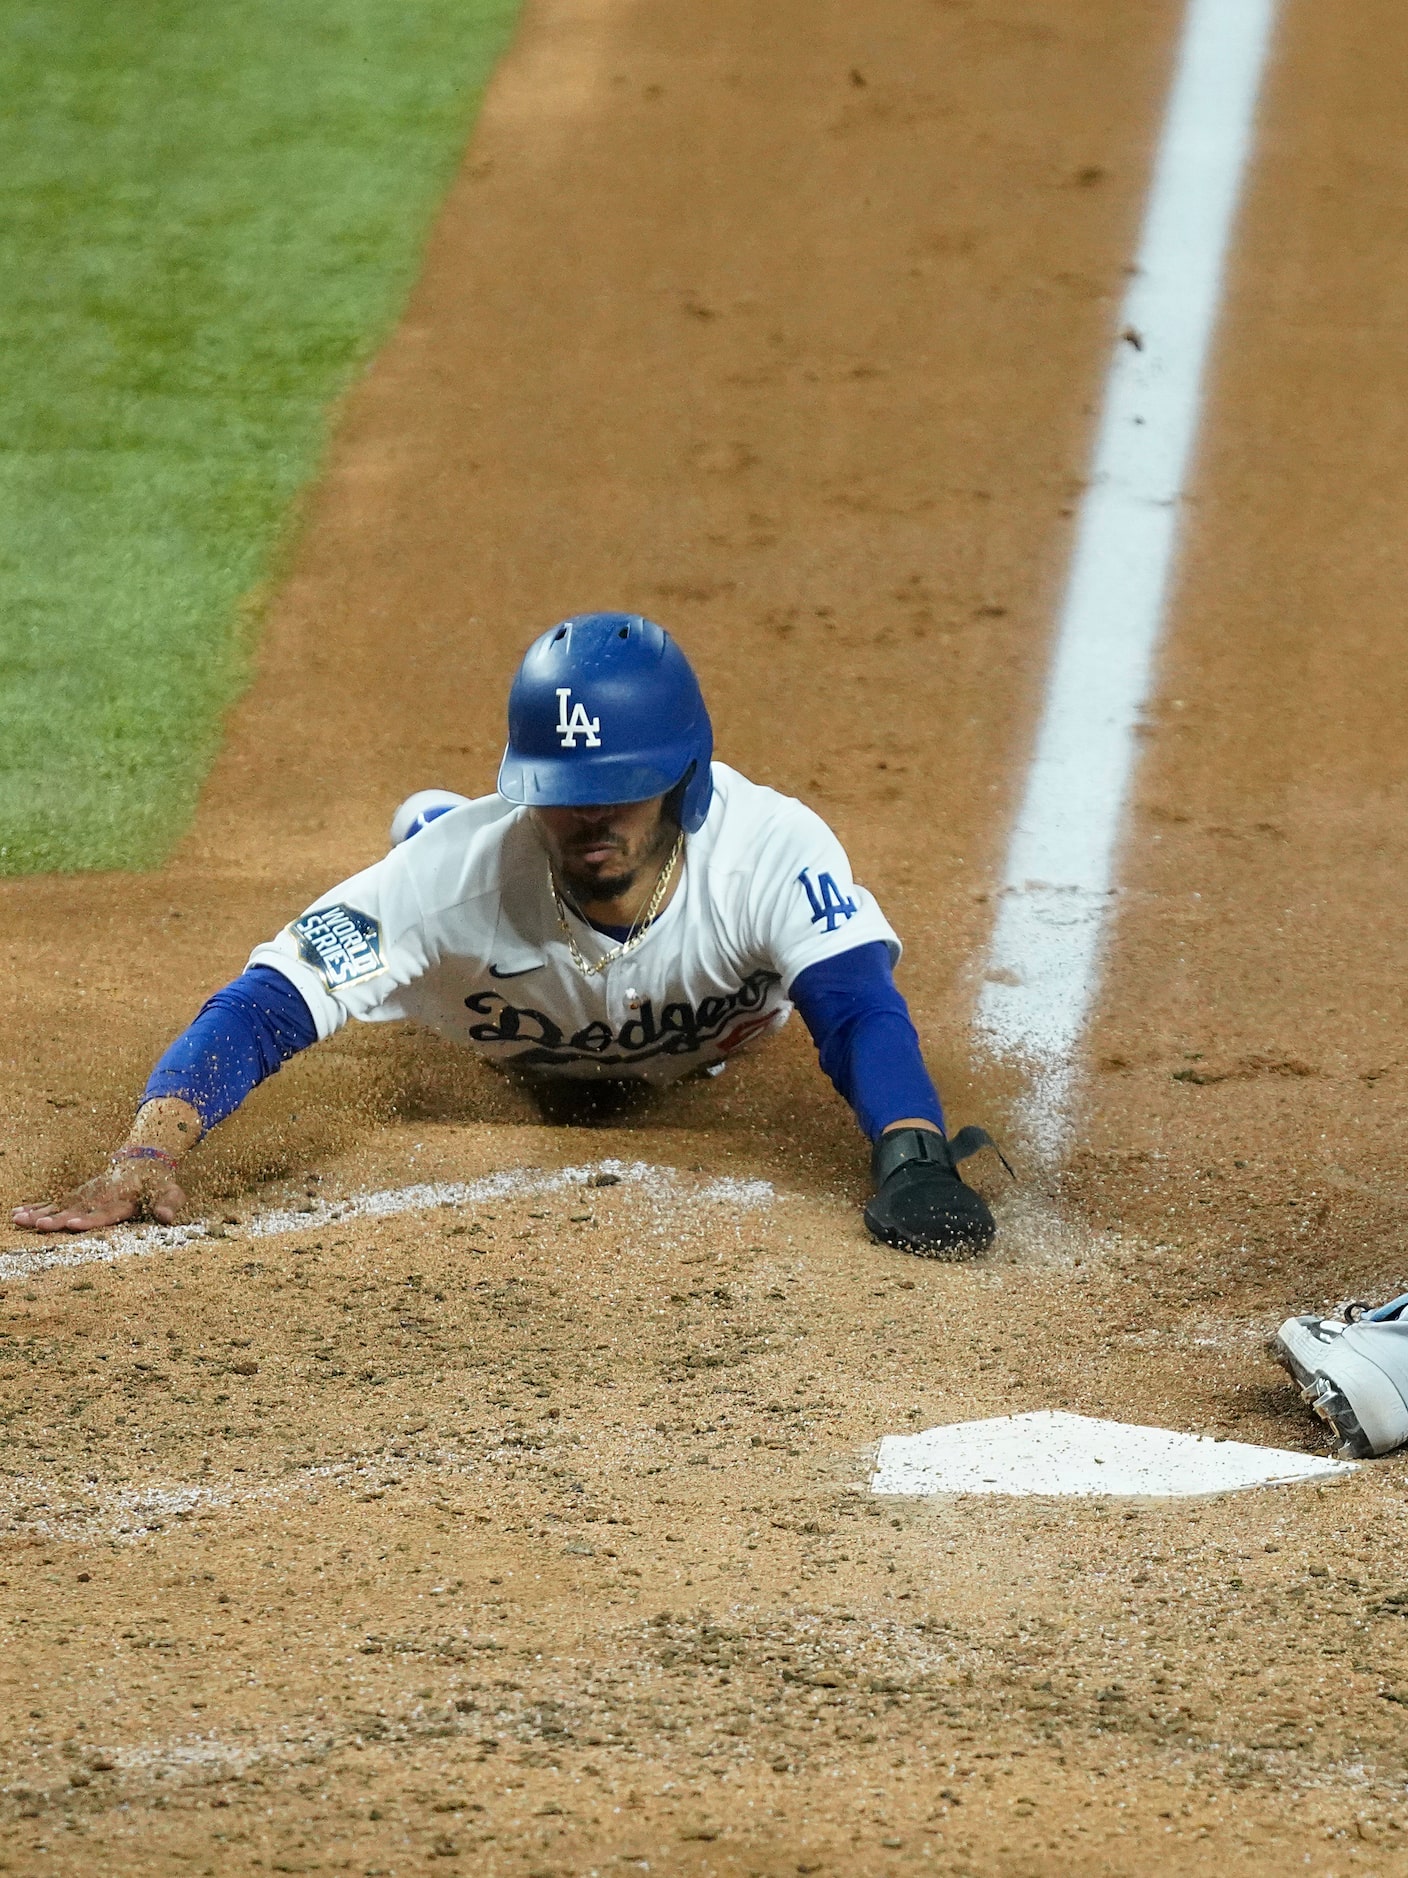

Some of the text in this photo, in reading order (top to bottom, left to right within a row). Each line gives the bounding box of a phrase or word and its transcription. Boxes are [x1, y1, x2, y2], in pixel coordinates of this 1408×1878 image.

[556, 688, 601, 747] LA
[793, 867, 857, 934] LA
[297, 916, 357, 984] SERIES
[321, 907, 378, 972] WORLD
[464, 968, 783, 1056] Dodgers
